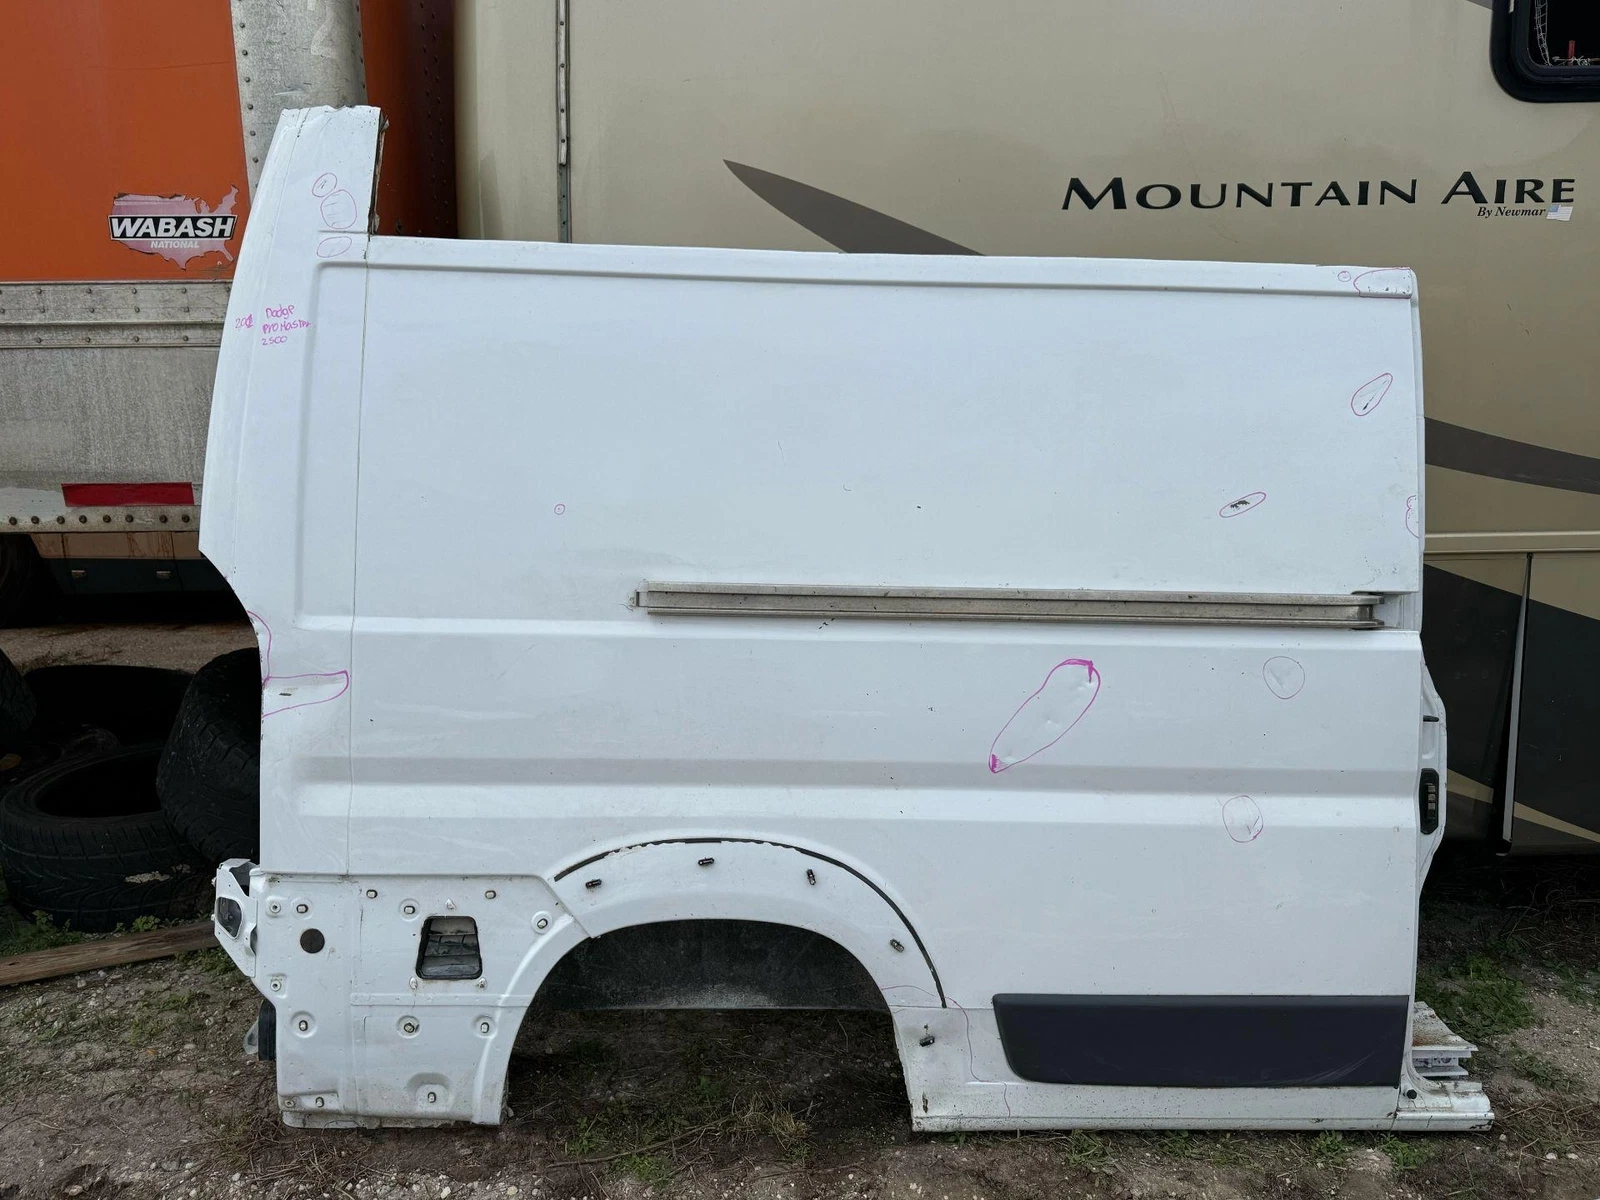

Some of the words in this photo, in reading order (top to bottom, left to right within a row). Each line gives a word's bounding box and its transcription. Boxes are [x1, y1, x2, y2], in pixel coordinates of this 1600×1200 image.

[1061, 177, 1417, 211] MOUNTAIN
[1440, 171, 1575, 205] AIRE
[1477, 206, 1493, 219] By
[1494, 206, 1546, 217] Newmar
[111, 217, 234, 238] WABASH
[150, 241, 200, 249] NATIONAL
[261, 335, 288, 346] 2500
